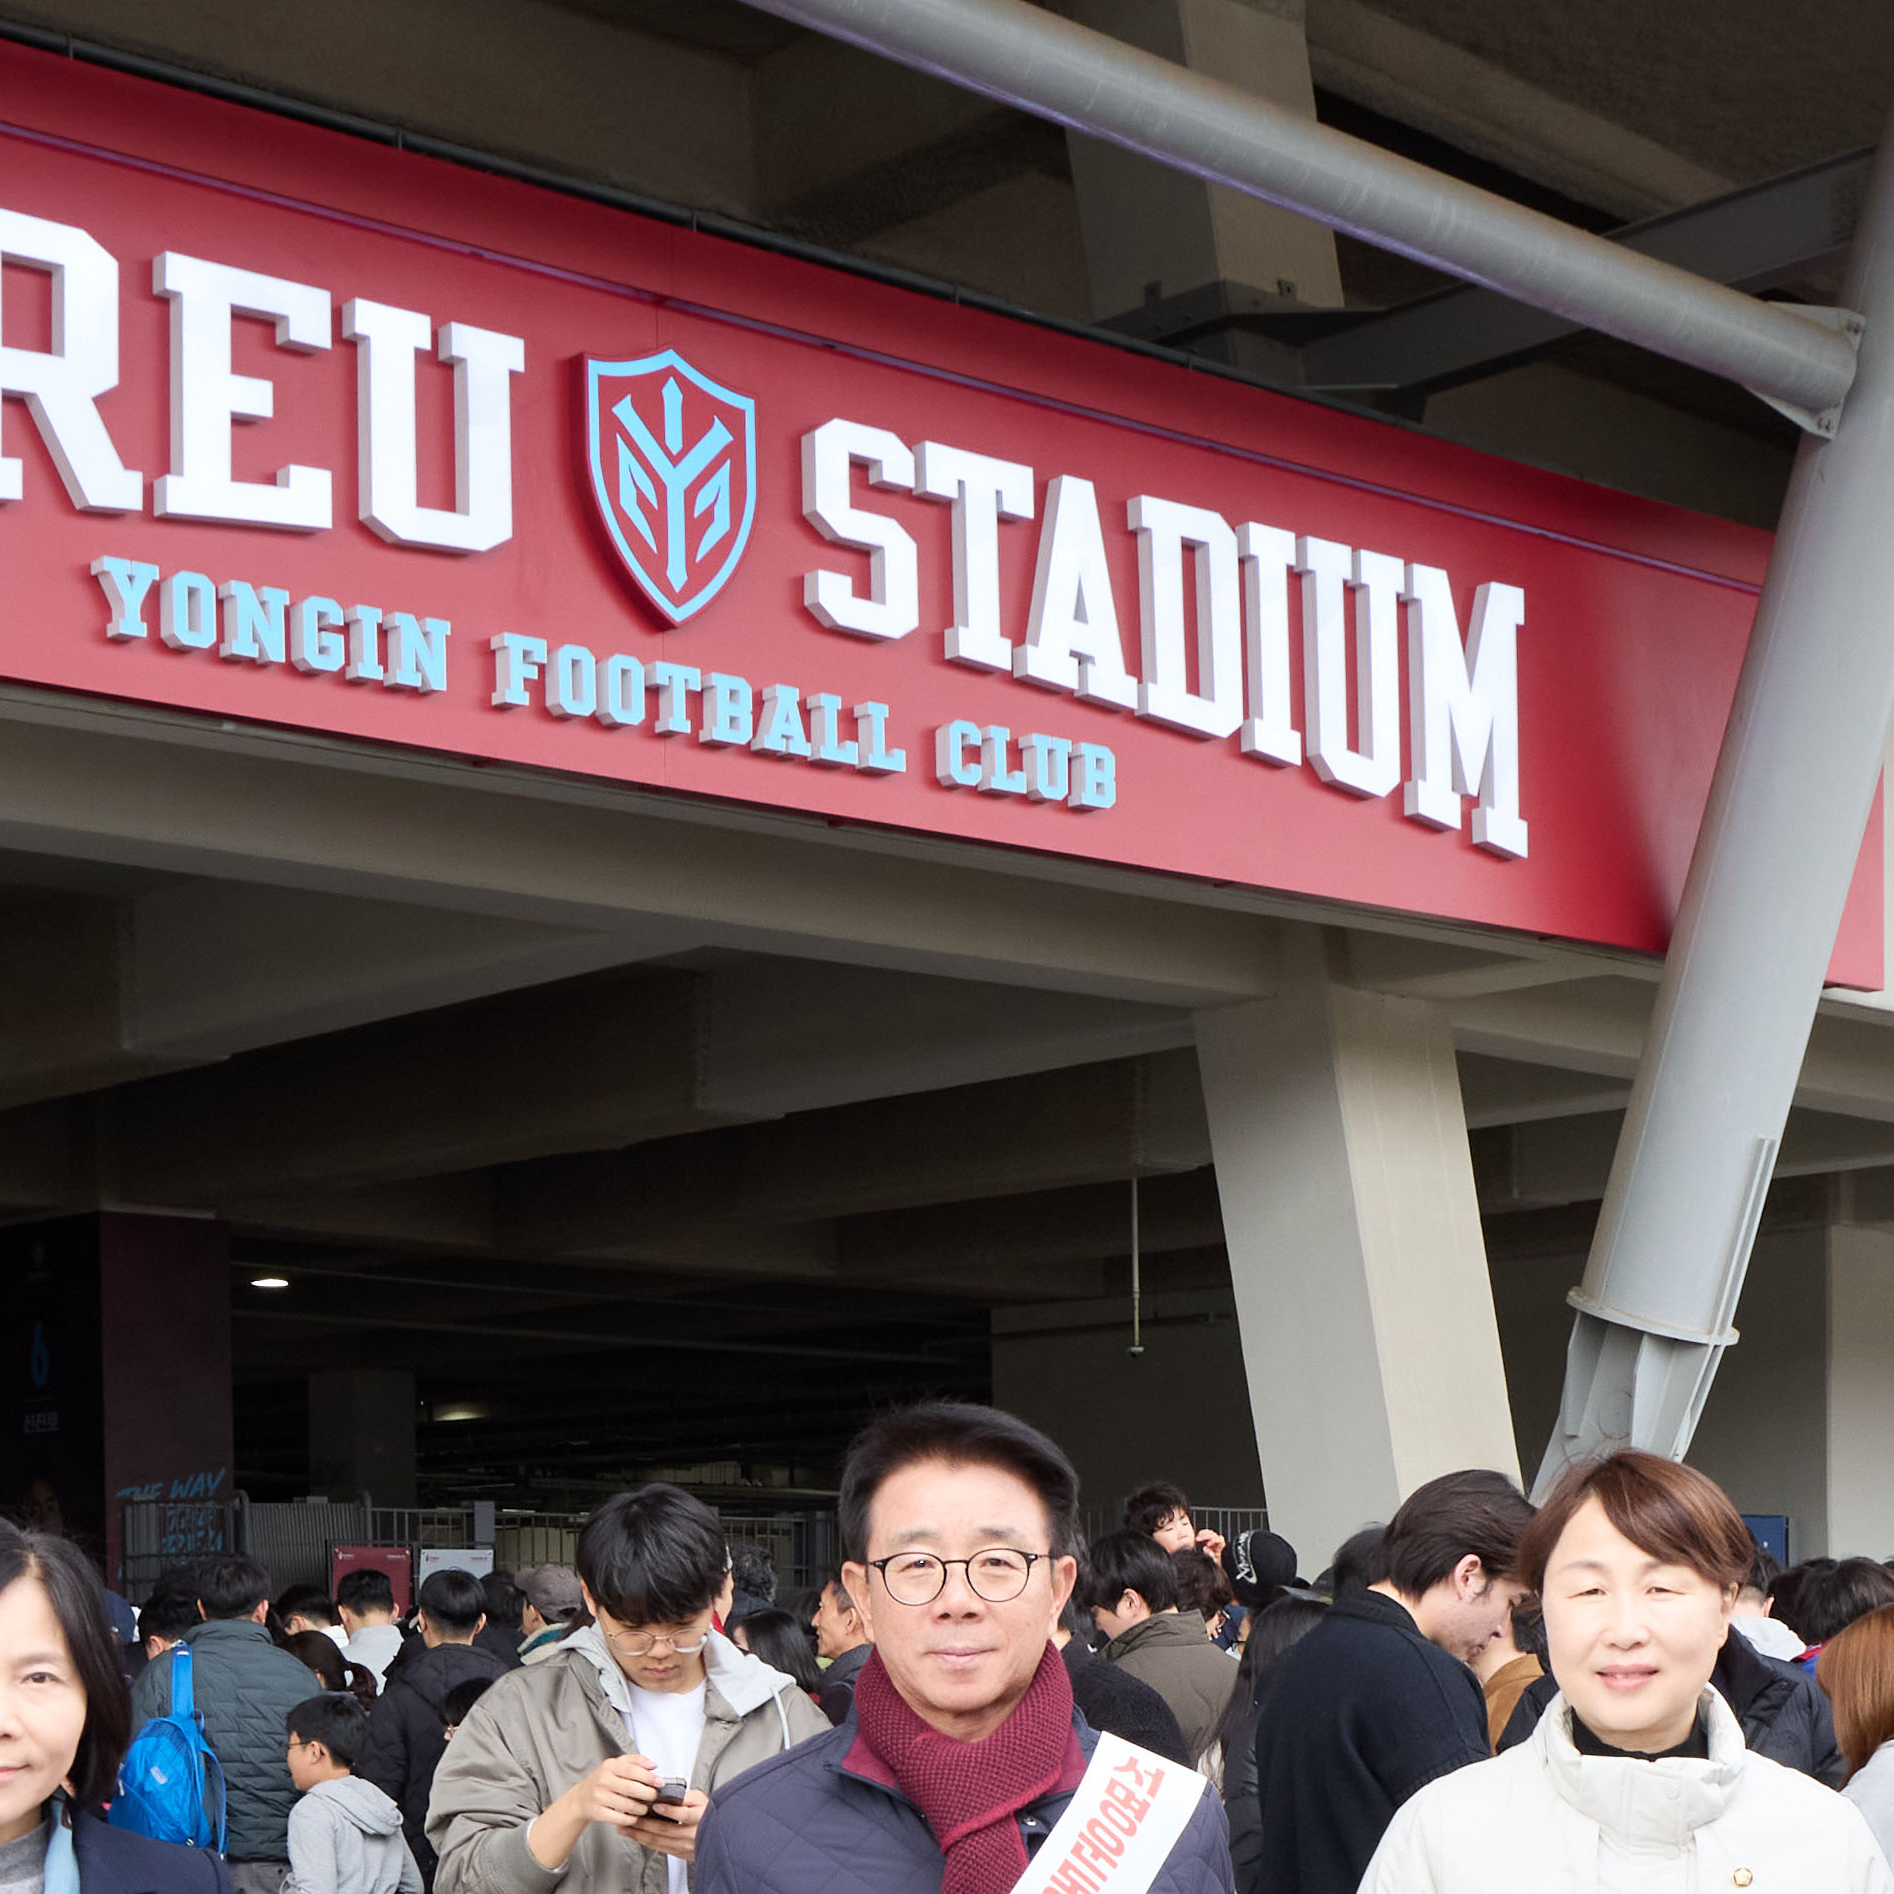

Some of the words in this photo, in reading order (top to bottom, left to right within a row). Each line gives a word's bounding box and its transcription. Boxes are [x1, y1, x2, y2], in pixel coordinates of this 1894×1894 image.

[95, 555, 449, 694] YONGIN
[491, 630, 909, 780] FOOTBALL
[935, 718, 1119, 814] CLUB
[800, 418, 1531, 860] STADIUM
[169, 1465, 227, 1500] WAY
